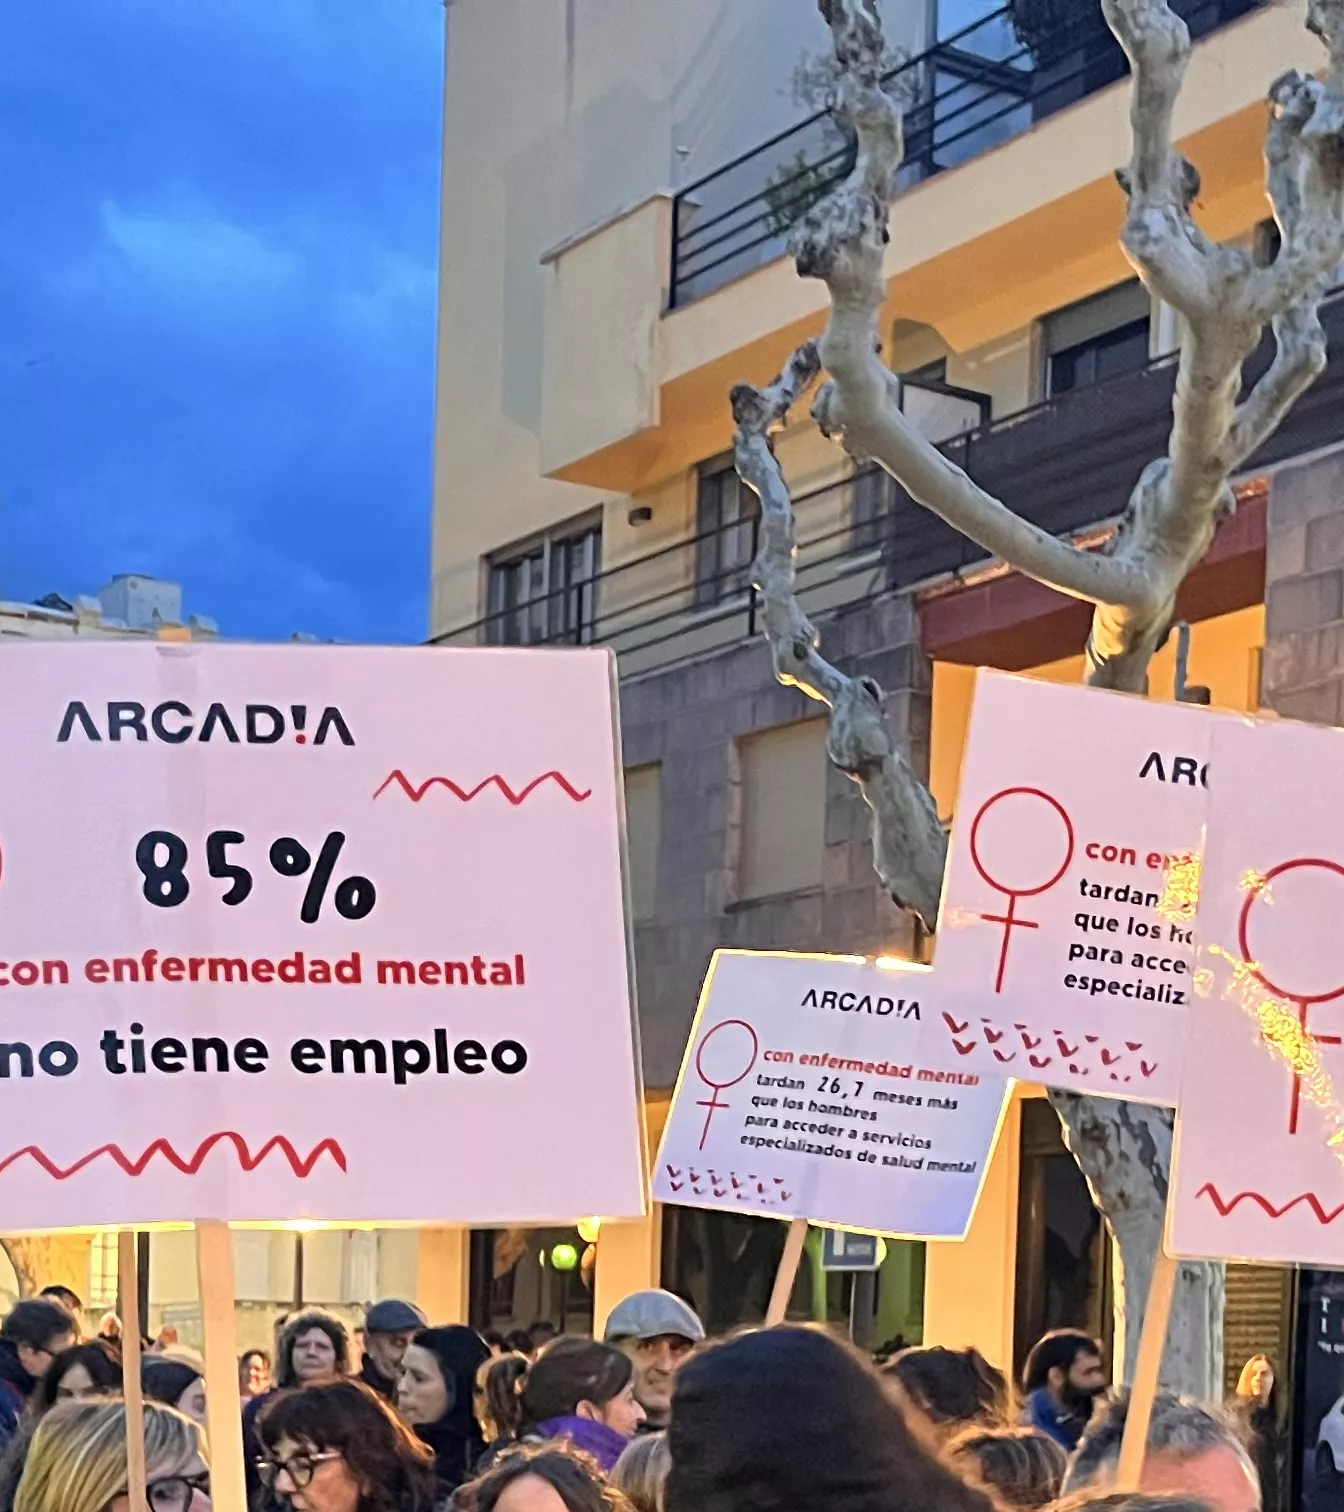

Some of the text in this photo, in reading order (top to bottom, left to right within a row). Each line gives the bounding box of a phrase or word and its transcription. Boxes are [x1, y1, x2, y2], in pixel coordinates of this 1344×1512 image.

[1139, 752, 1207, 787] AR
[1086, 843, 1136, 865] con
[136, 831, 376, 923] 85%
[1080, 879, 1158, 907] tardan
[1075, 913, 1119, 932] que
[1127, 917, 1160, 939] los
[85, 949, 361, 984] enfermedad
[377, 954, 525, 985] mental
[1069, 944, 1122, 964] para
[1064, 974, 1184, 1005] especializ
[100, 1023, 268, 1074] tiene
[291, 1029, 527, 1084] empleo
[764, 1051, 979, 1085] con enfermedad mental
[752, 1096, 877, 1121] que los hombres
[757, 1074, 959, 1110] tardan 26,7 meses más
[745, 1116, 931, 1149] para acceder a servicios
[739, 1133, 976, 1173] especializados de salud mental
